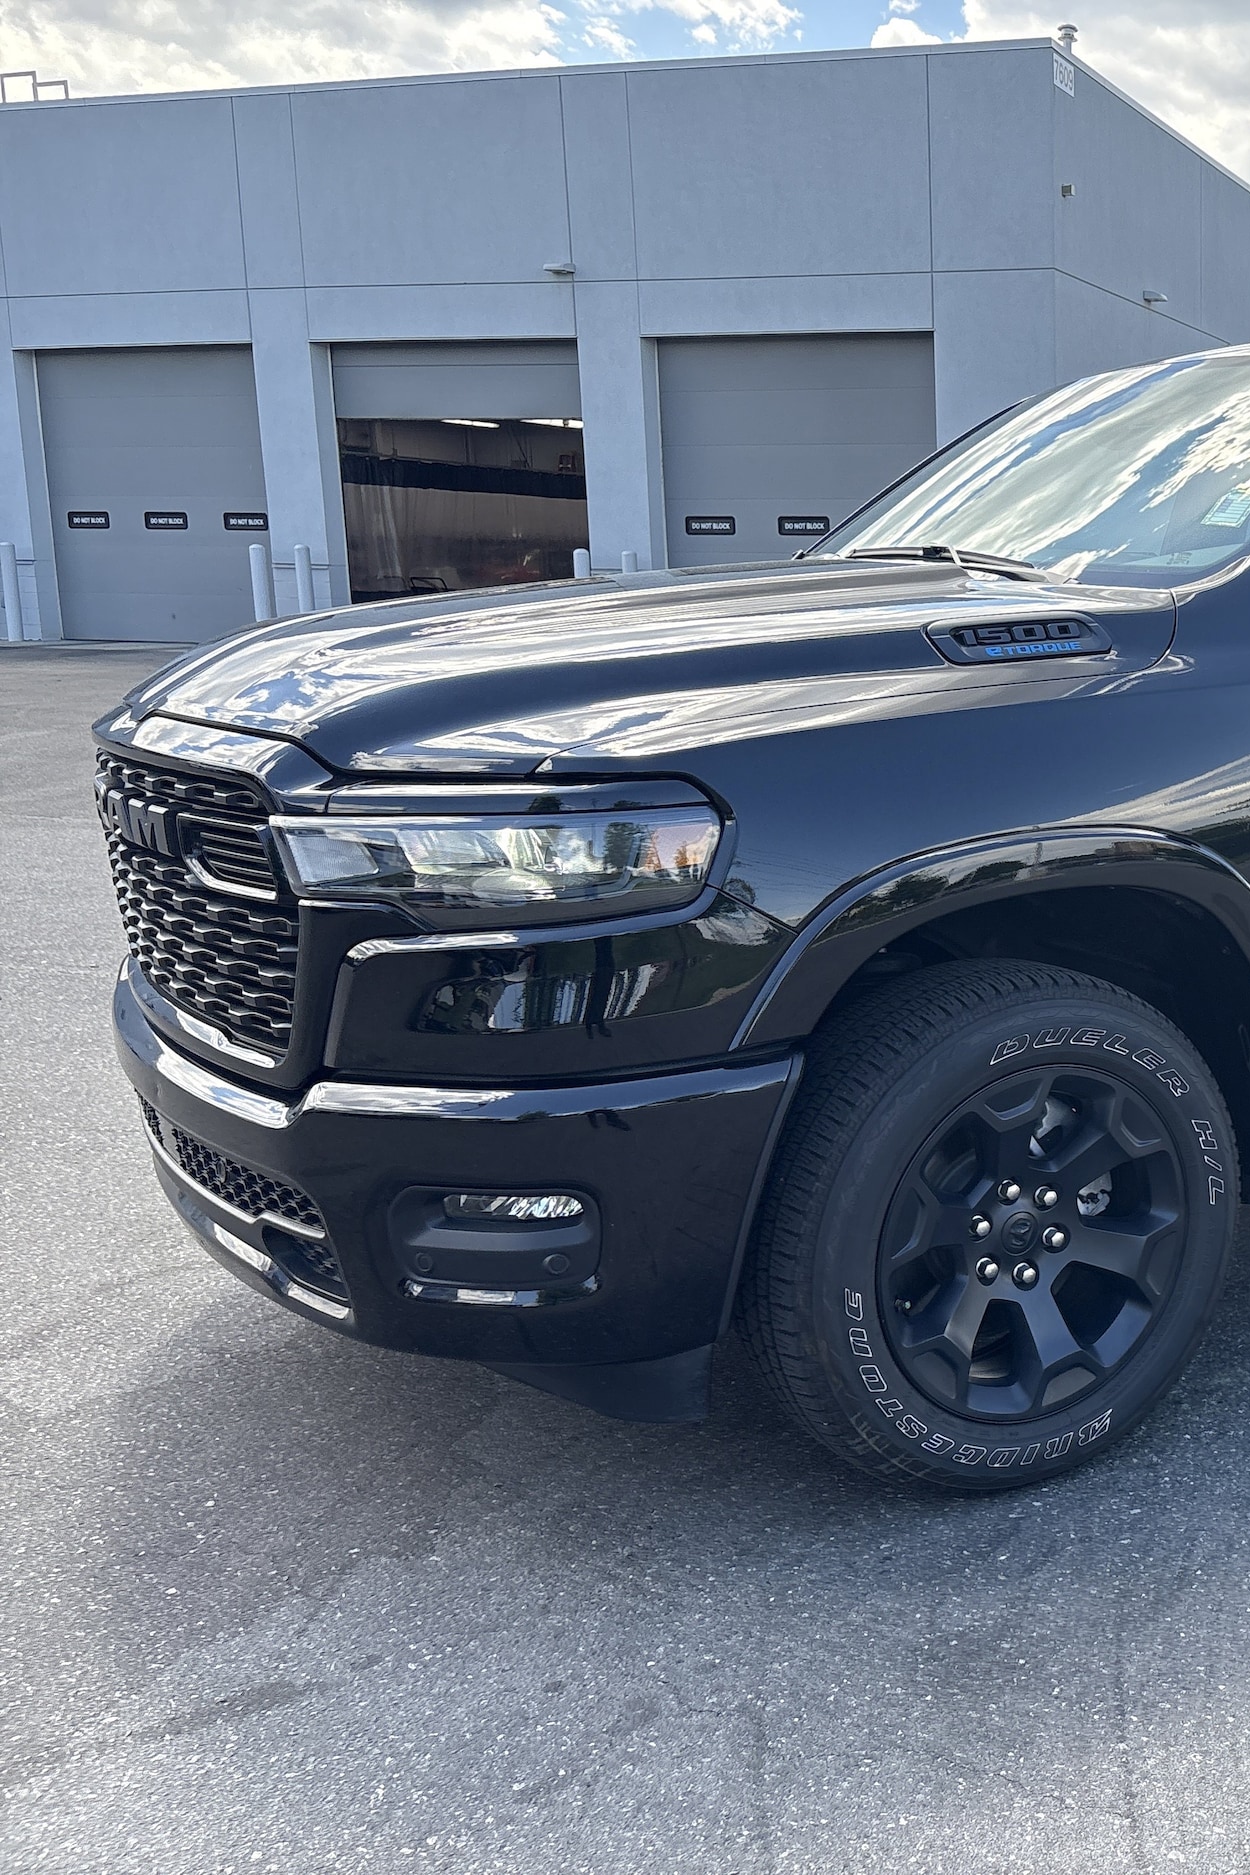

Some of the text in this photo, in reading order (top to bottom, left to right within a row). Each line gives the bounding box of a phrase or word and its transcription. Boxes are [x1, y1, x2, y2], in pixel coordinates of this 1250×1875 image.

[1054, 58, 1074, 91] 7609
[73, 516, 106, 524] DO NOT BLOCK
[150, 517, 184, 525] DO NOT BLOCK
[230, 518, 264, 526] DO NOT BLOCK
[958, 620, 1081, 647] 1500
[985, 641, 1083, 657] eTORQUE
[989, 1026, 1226, 1207] DUELER H/L
[842, 1286, 1114, 1469] BRIDGESTONE
